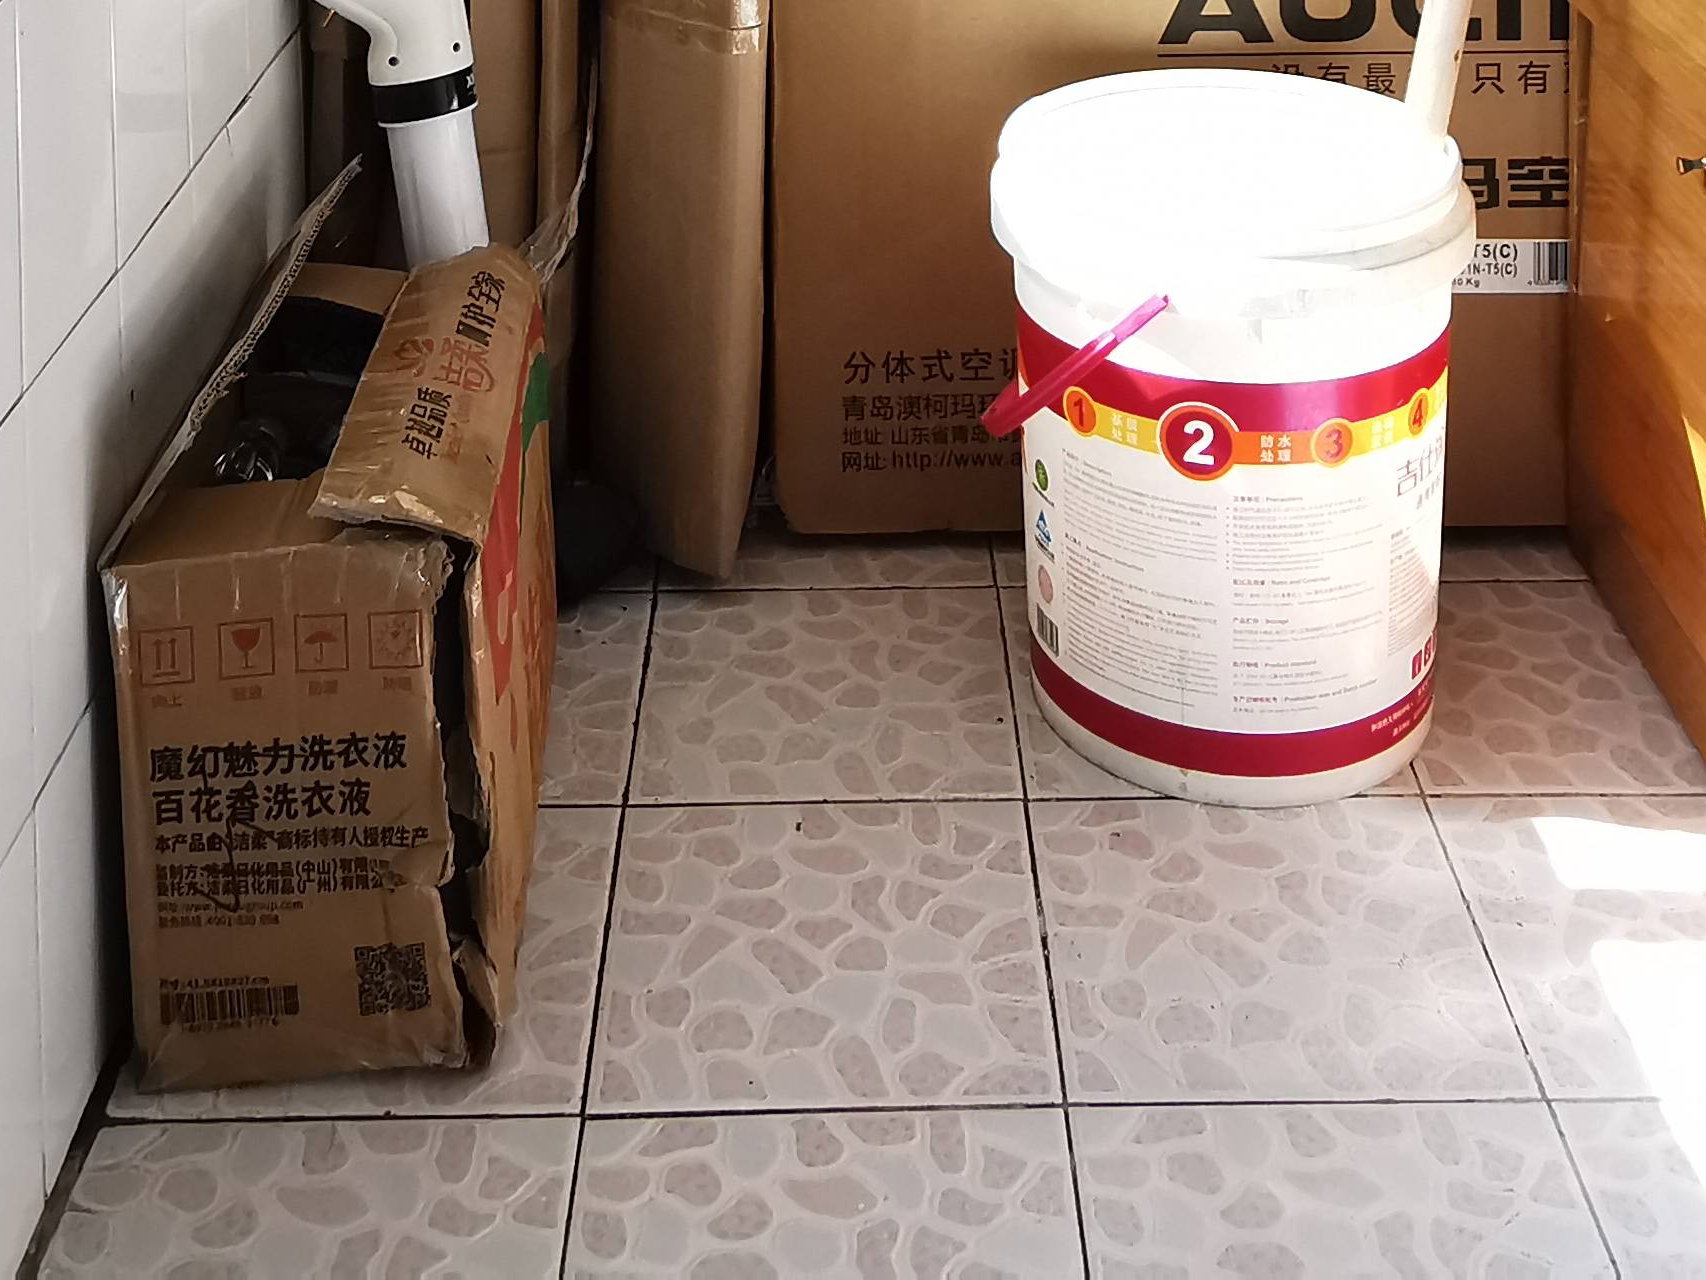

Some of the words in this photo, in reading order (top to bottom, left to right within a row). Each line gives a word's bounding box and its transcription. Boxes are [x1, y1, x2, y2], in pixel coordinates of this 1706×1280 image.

[1071, 397, 1089, 427] 1
[1412, 397, 1424, 428] 4
[1181, 419, 1216, 466] 2
[1259, 434, 1293, 450] 防水
[1259, 447, 1293, 464] 处理
[1324, 433, 1344, 459] 3
[149, 731, 408, 783] 魔幻魅力洗衣液
[152, 777, 372, 826] 百花香洗衣液
